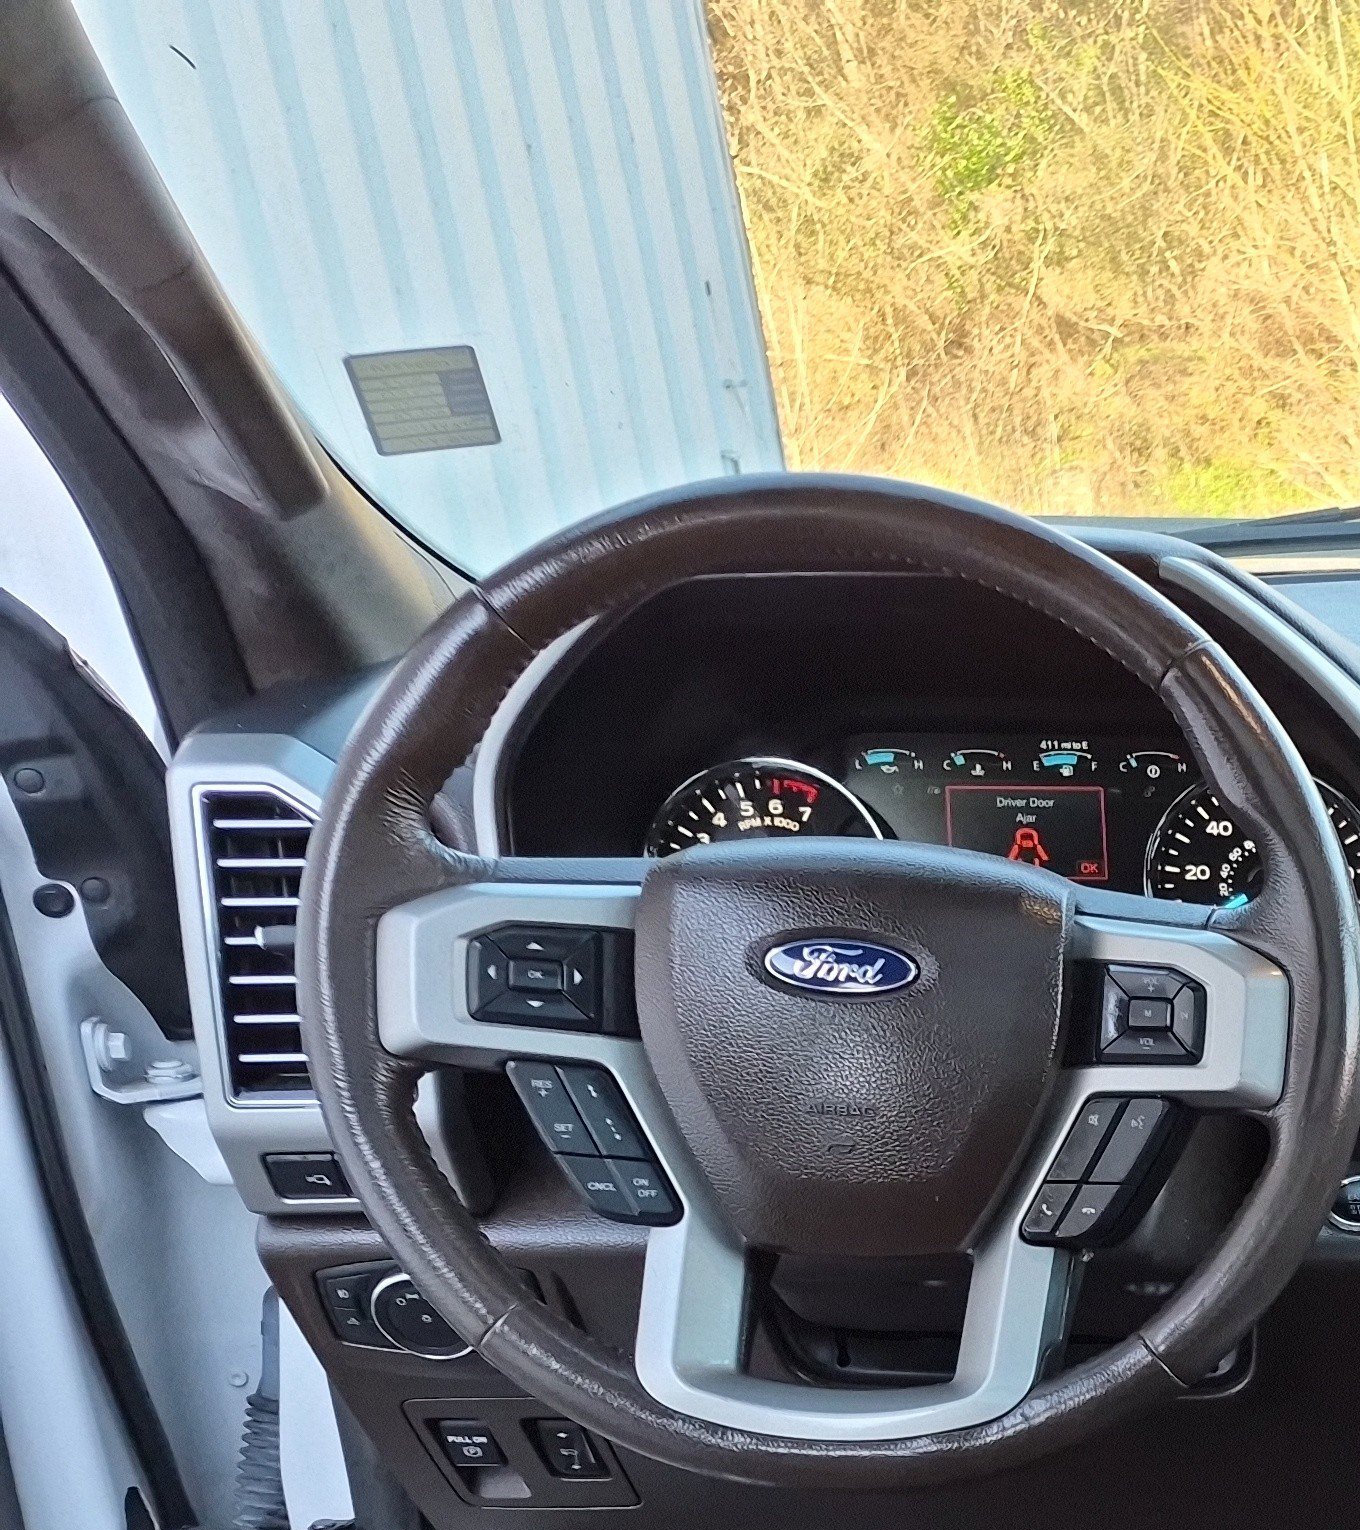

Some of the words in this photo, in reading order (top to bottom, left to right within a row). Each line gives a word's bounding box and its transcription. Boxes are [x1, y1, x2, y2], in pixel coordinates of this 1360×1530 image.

[1040, 740, 1059, 750] 411
[1061, 741, 1072, 749] mi
[1072, 741, 1081, 750] to
[1082, 740, 1089, 750] E
[914, 760, 924, 771] H
[943, 760, 952, 771] C
[1002, 760, 1012, 772] H
[1032, 760, 1040, 772] E
[1091, 760, 1098, 772] F
[1119, 761, 1128, 773] C
[1177, 762, 1188, 773] H
[740, 800, 754, 816] 5
[768, 798, 784, 814] 6
[996, 797, 1027, 808] Driver
[1029, 798, 1055, 808] Door
[712, 812, 728, 828] 4
[798, 806, 812, 822] 7
[1016, 812, 1037, 824] Ajar
[738, 816, 762, 832] RPM
[773, 816, 800, 832] 1000
[1205, 820, 1233, 837] 40
[1228, 847, 1242, 862] 60
[1080, 862, 1099, 874] OK
[1184, 864, 1211, 882] 20
[1220, 863, 1230, 878] 40
[1218, 882, 1230, 897] 20
[792, 944, 886, 985] Ford
[528, 969, 545, 980] OK
[1144, 1010, 1152, 1018] M
[1139, 1037, 1156, 1046] VOL
[530, 1080, 553, 1089] RES
[805, 1104, 879, 1118] AIRBAG
[553, 1123, 574, 1132] SET
[586, 1182, 618, 1192] CNCL
[632, 1178, 650, 1187] ON
[638, 1189, 659, 1198] OFF
